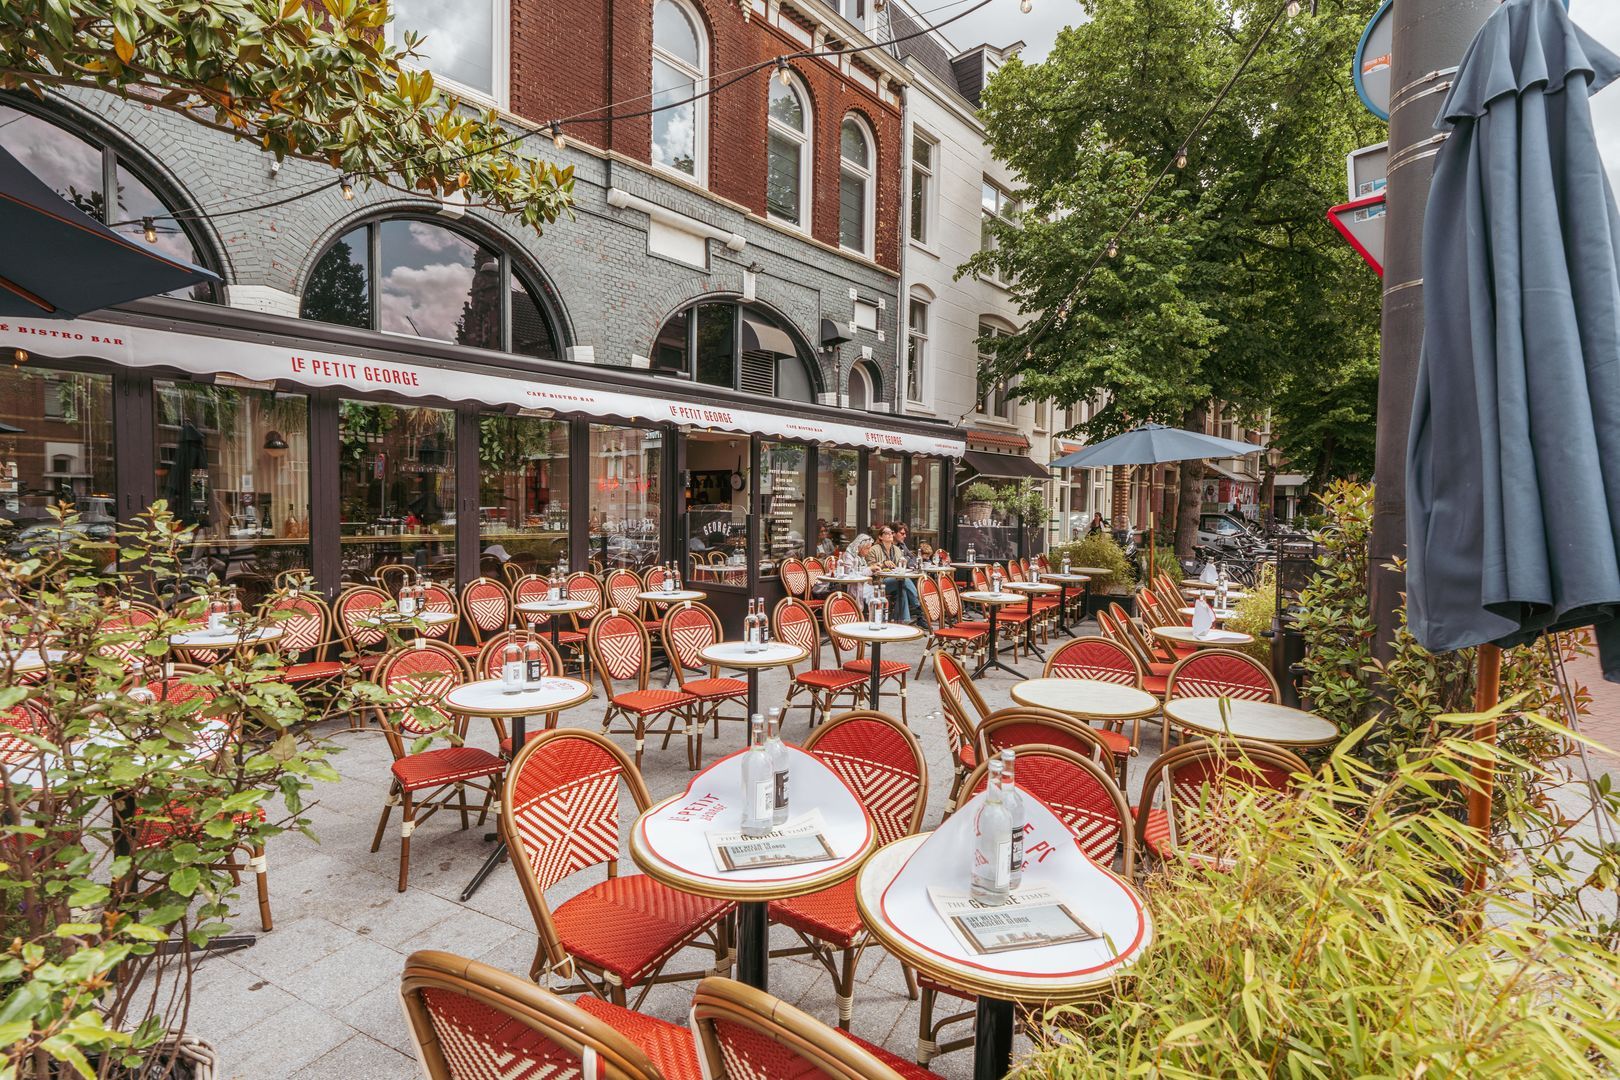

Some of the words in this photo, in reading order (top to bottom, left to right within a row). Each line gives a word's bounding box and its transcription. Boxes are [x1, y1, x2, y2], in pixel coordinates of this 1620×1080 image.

[18, 326, 84, 341] BISTRO
[90, 335, 124, 346] BAR
[291, 356, 306, 373] LE
[311, 359, 357, 380] PETIT
[363, 366, 420, 387] GEORGE
[549, 393, 578, 401] BISTRO
[669, 405, 678, 417] LE
[679, 407, 702, 420] PETIT
[703, 410, 733, 424] GEORGE
[870, 433, 885, 444] PETIT
[884, 435, 903, 446] GEORGE
[703, 521, 732, 537] GEORGE
[972, 518, 1001, 529] GEORGE
[677, 793, 720, 815] PETIT
[979, 914, 1001, 922] HELLO
[1006, 916, 1031, 925] GEORGE
